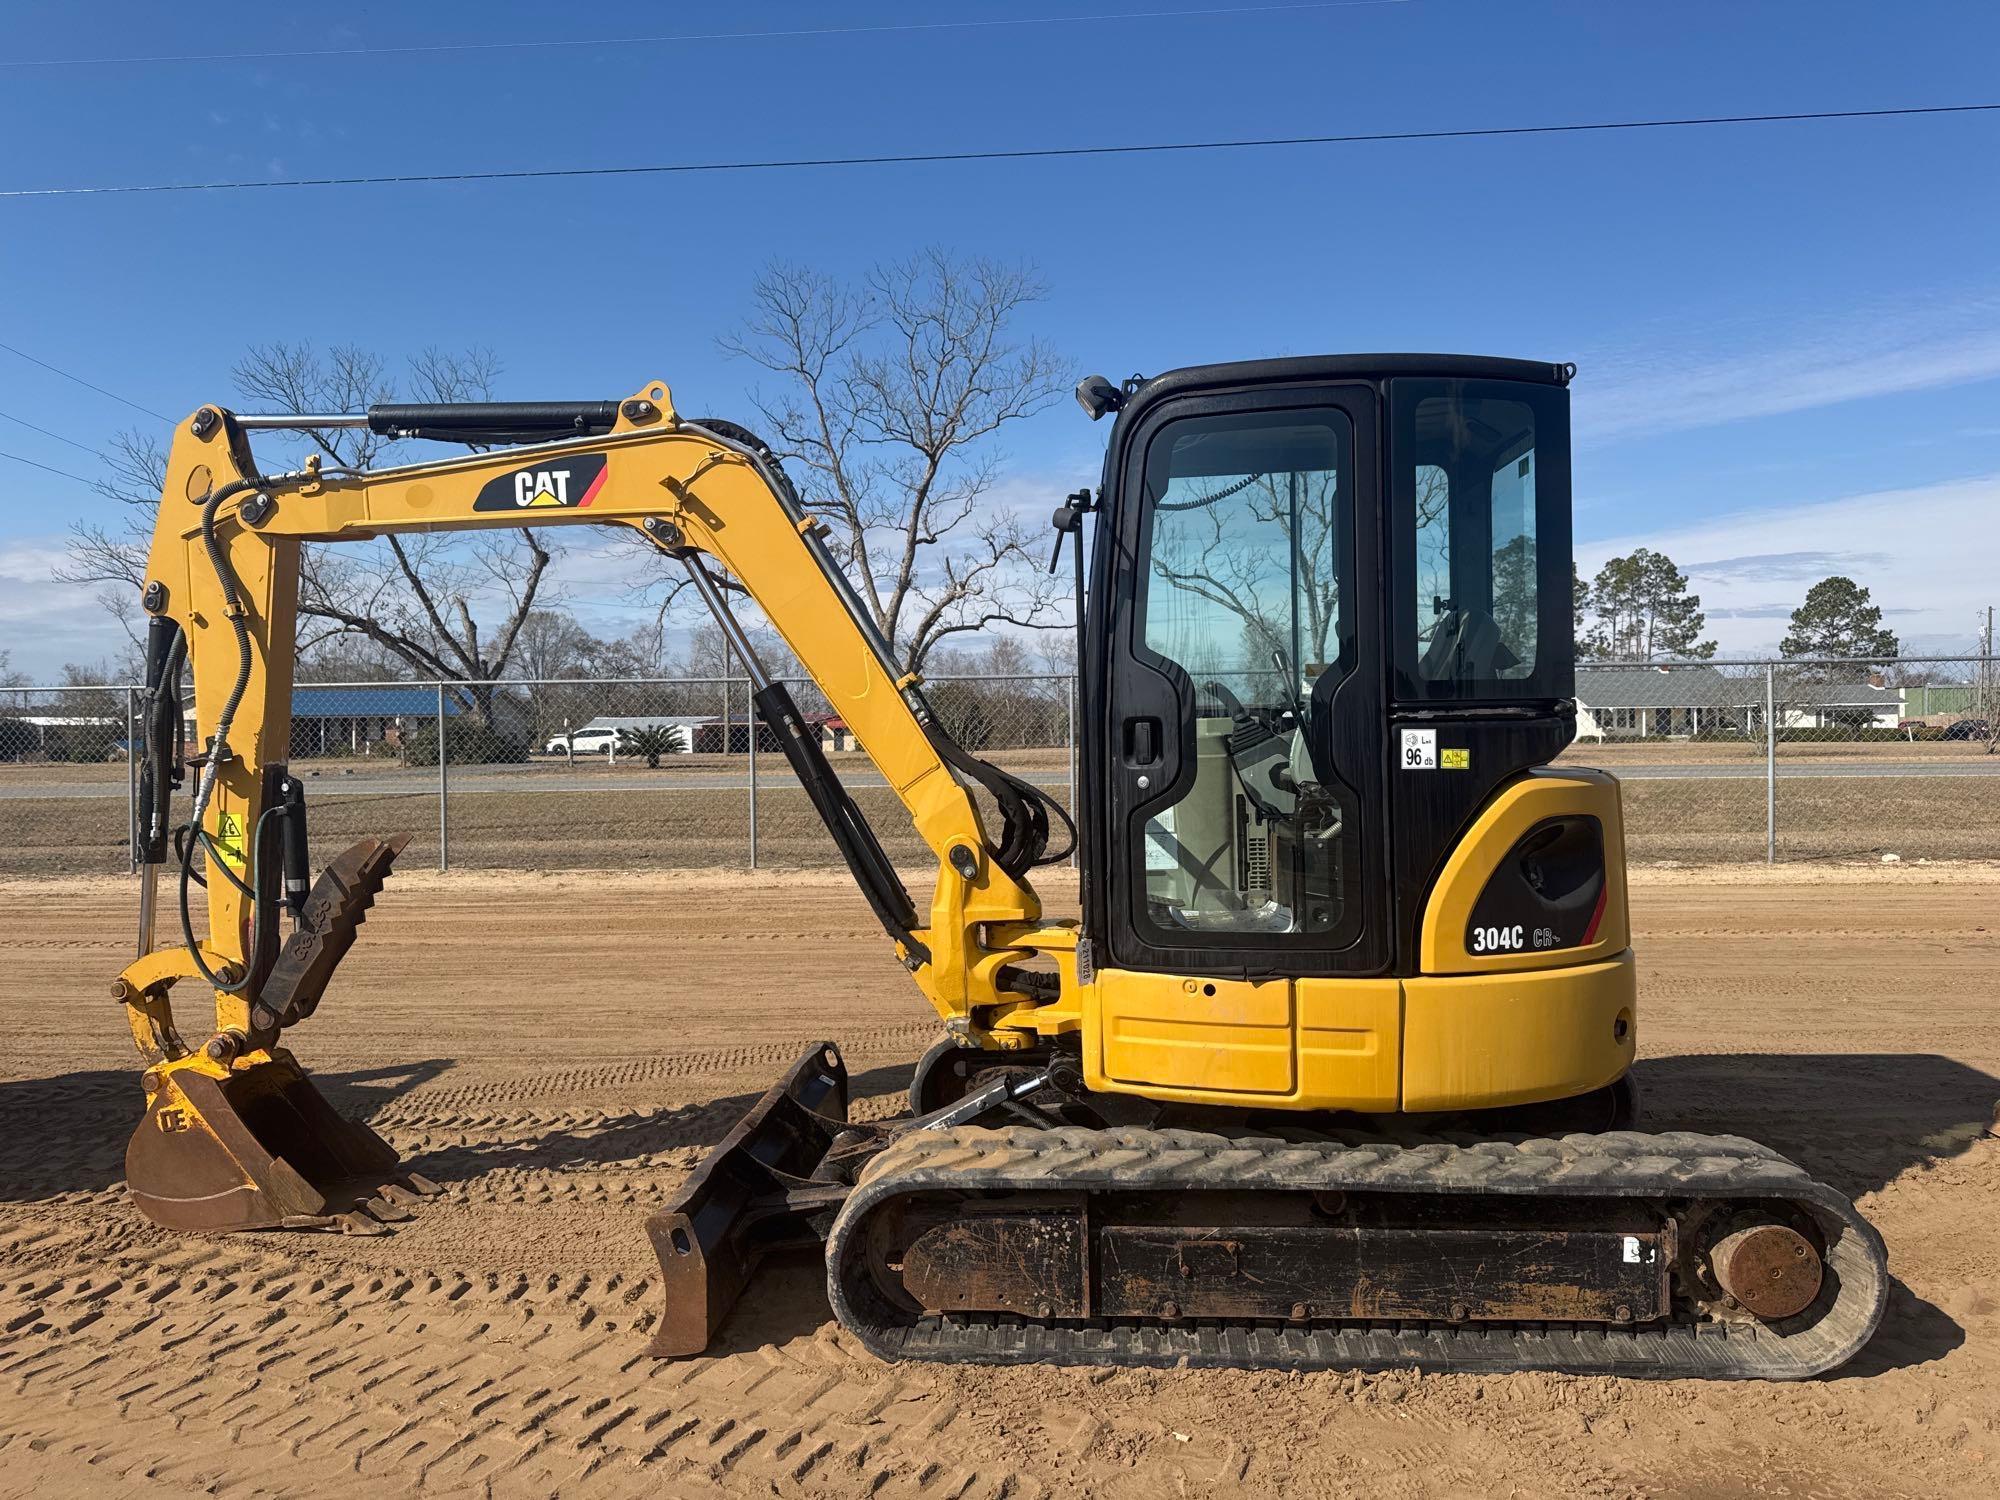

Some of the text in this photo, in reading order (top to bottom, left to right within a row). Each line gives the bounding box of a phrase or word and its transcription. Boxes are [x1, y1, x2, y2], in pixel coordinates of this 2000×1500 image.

[514, 470, 570, 507] CAT
[1406, 748, 1433, 766] 96 db
[1473, 924, 1552, 952] 304C CR
